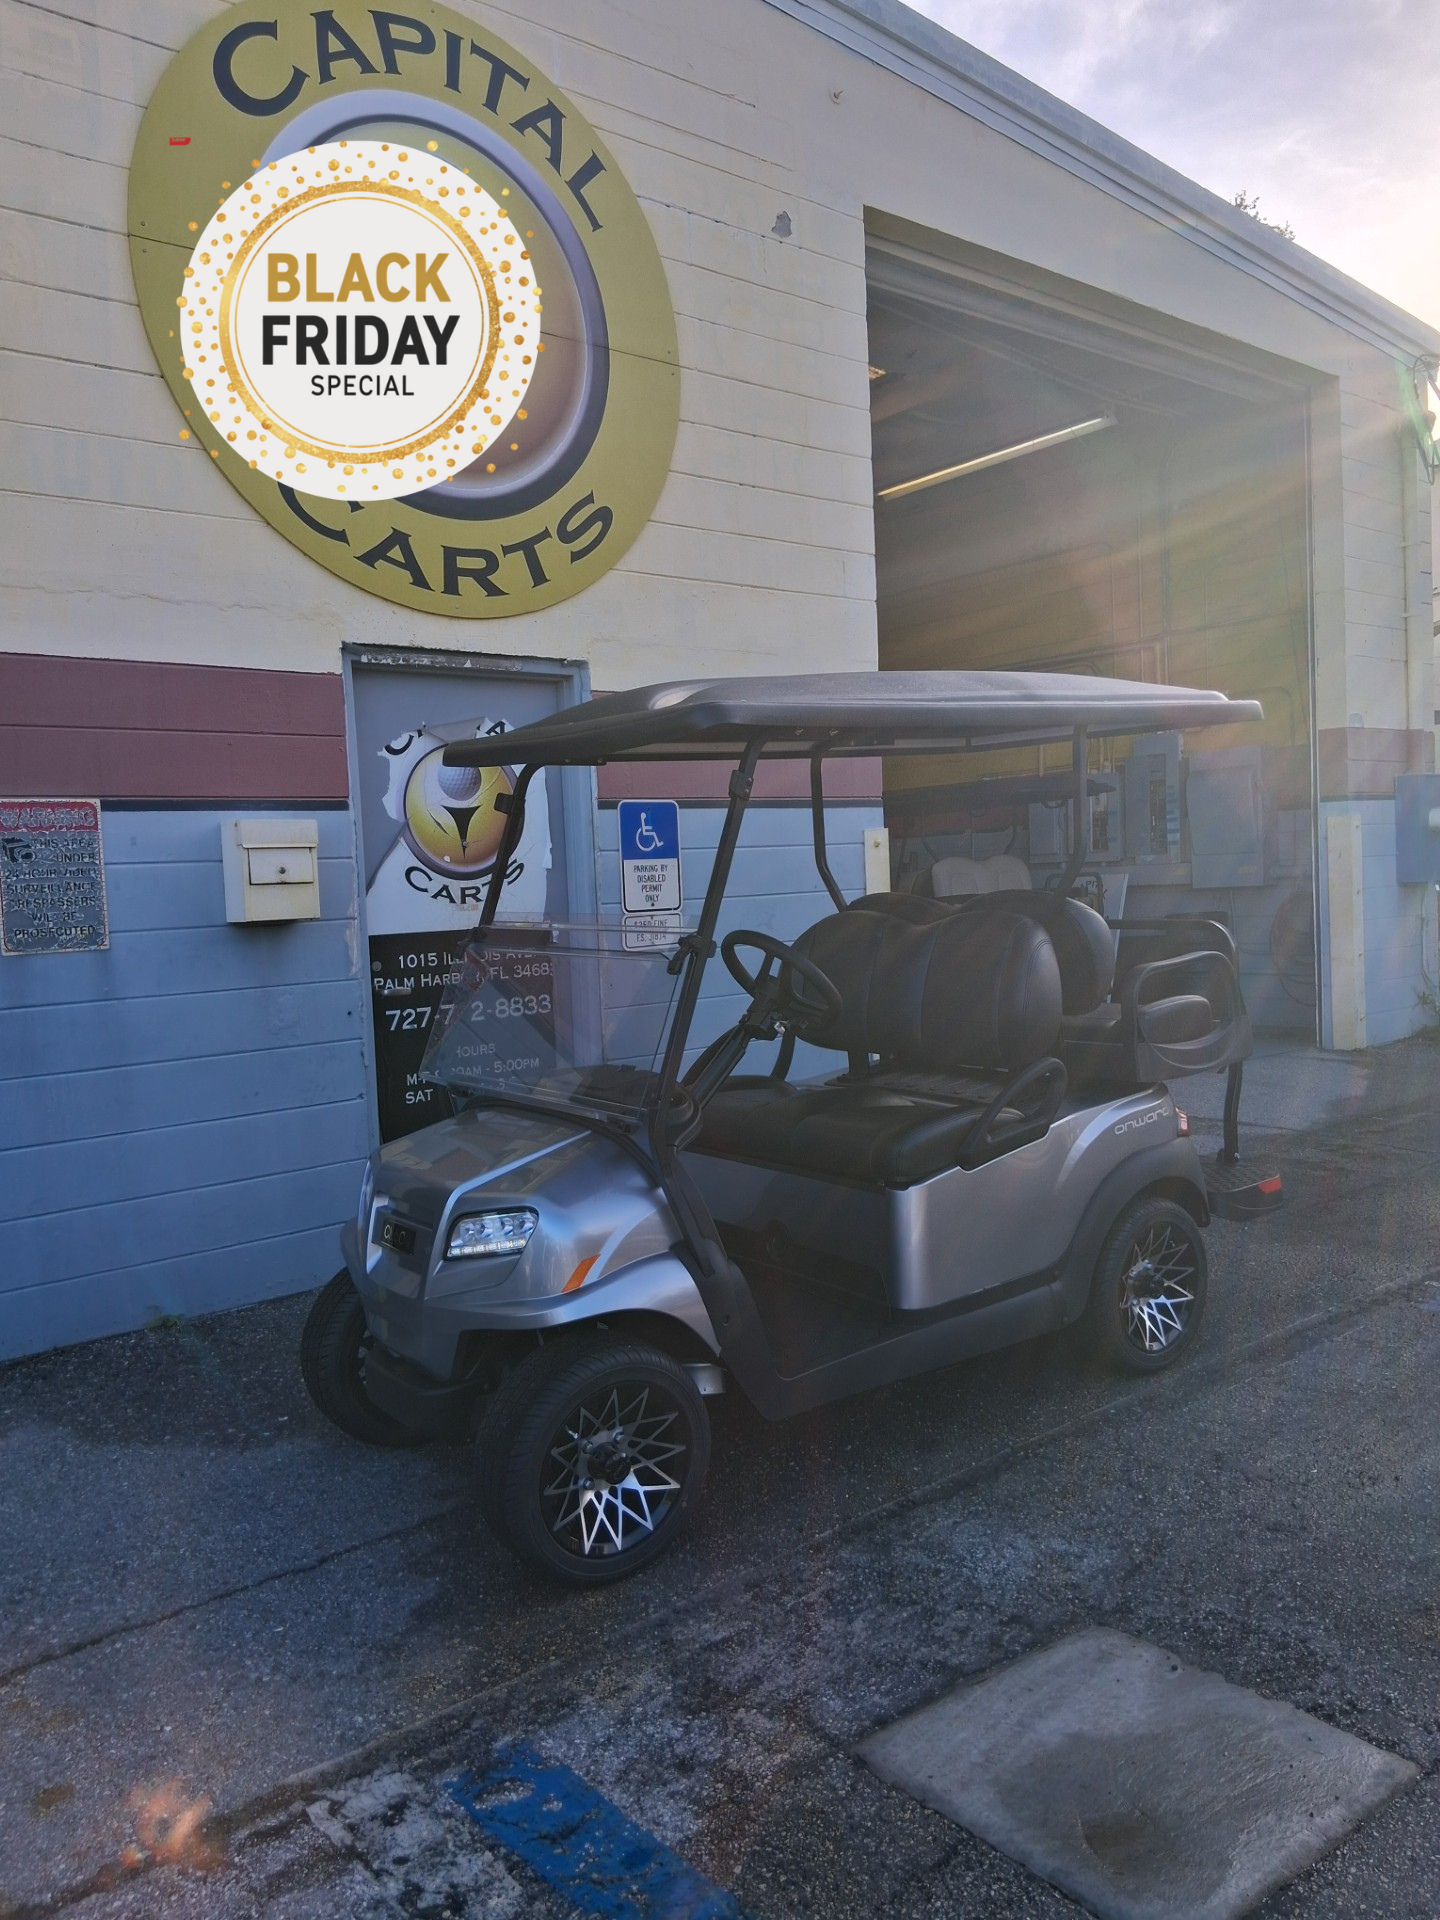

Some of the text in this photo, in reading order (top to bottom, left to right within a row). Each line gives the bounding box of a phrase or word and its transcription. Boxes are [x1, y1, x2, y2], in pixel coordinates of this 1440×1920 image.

[211, 9, 608, 233] CAPITAL
[634, 864, 669, 873] PARKING BY
[636, 873, 666, 884] DISABLED
[641, 884, 663, 893] PERMIT
[645, 894, 660, 903] ONLY
[399, 951, 438, 969] 1015
[374, 976, 415, 991] PALM
[490, 967, 510, 981] FL
[494, 1057, 541, 1074] 5:00PM
[405, 1089, 434, 1104] SAT
